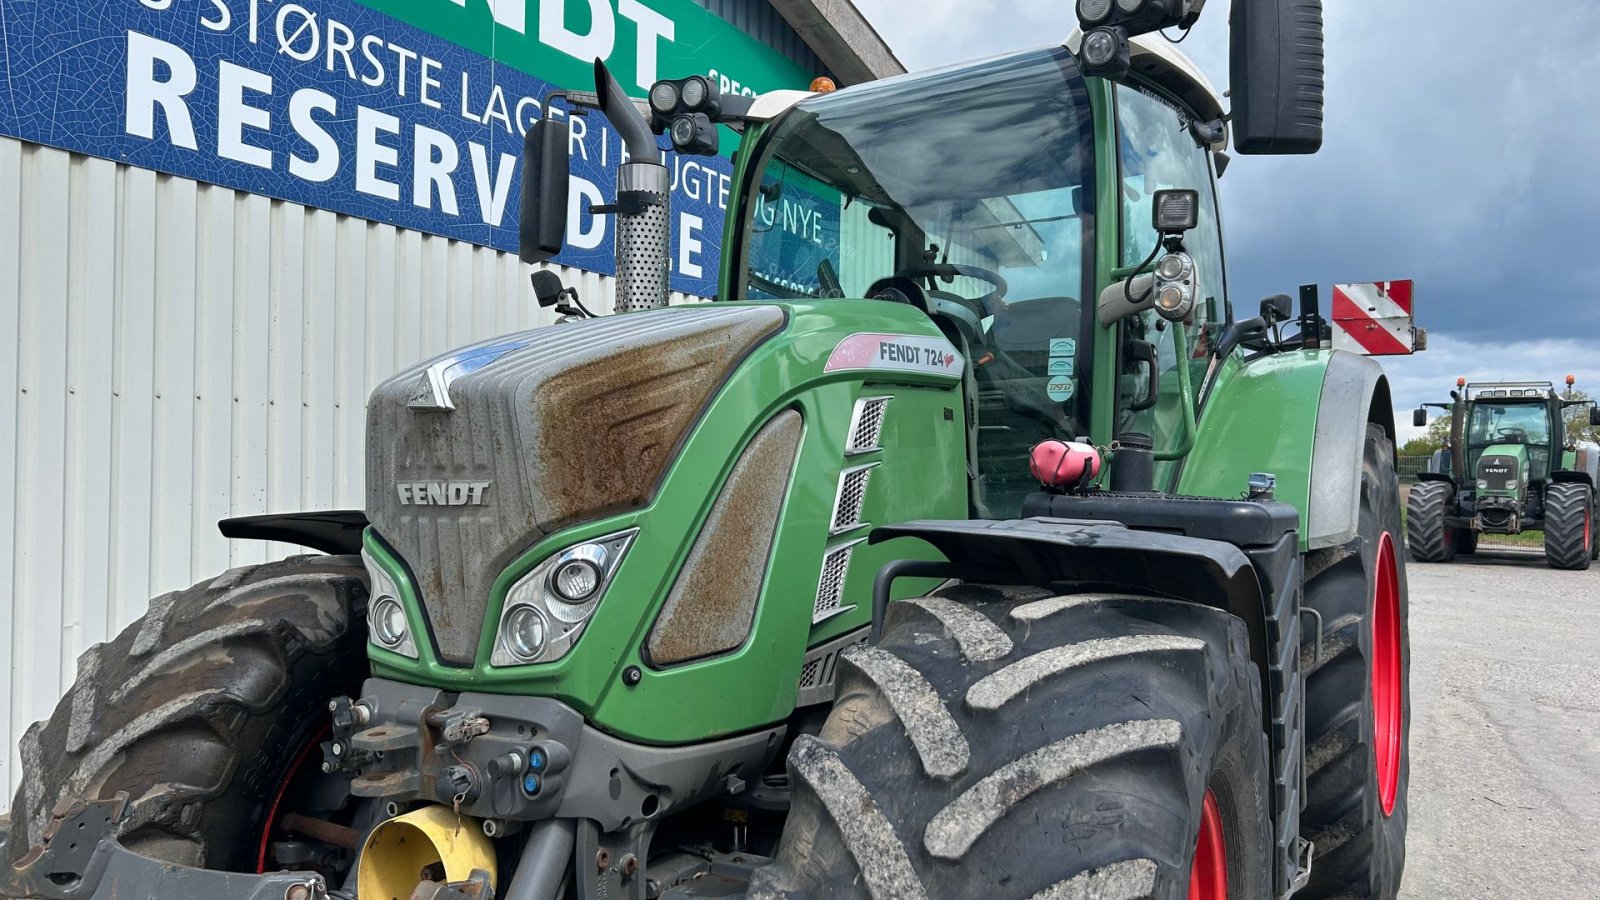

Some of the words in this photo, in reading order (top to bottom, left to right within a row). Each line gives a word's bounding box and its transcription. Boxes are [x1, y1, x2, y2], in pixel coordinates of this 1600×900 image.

[126, 30, 703, 278] RESERVDE
[200, 0, 442, 109] STØRSTE
[601, 127, 608, 167] I
[621, 138, 731, 210] UGTE
[783, 198, 822, 244] NYE
[880, 341, 921, 364] FENDT
[924, 348, 944, 367] 724
[396, 481, 492, 506] FENDT
